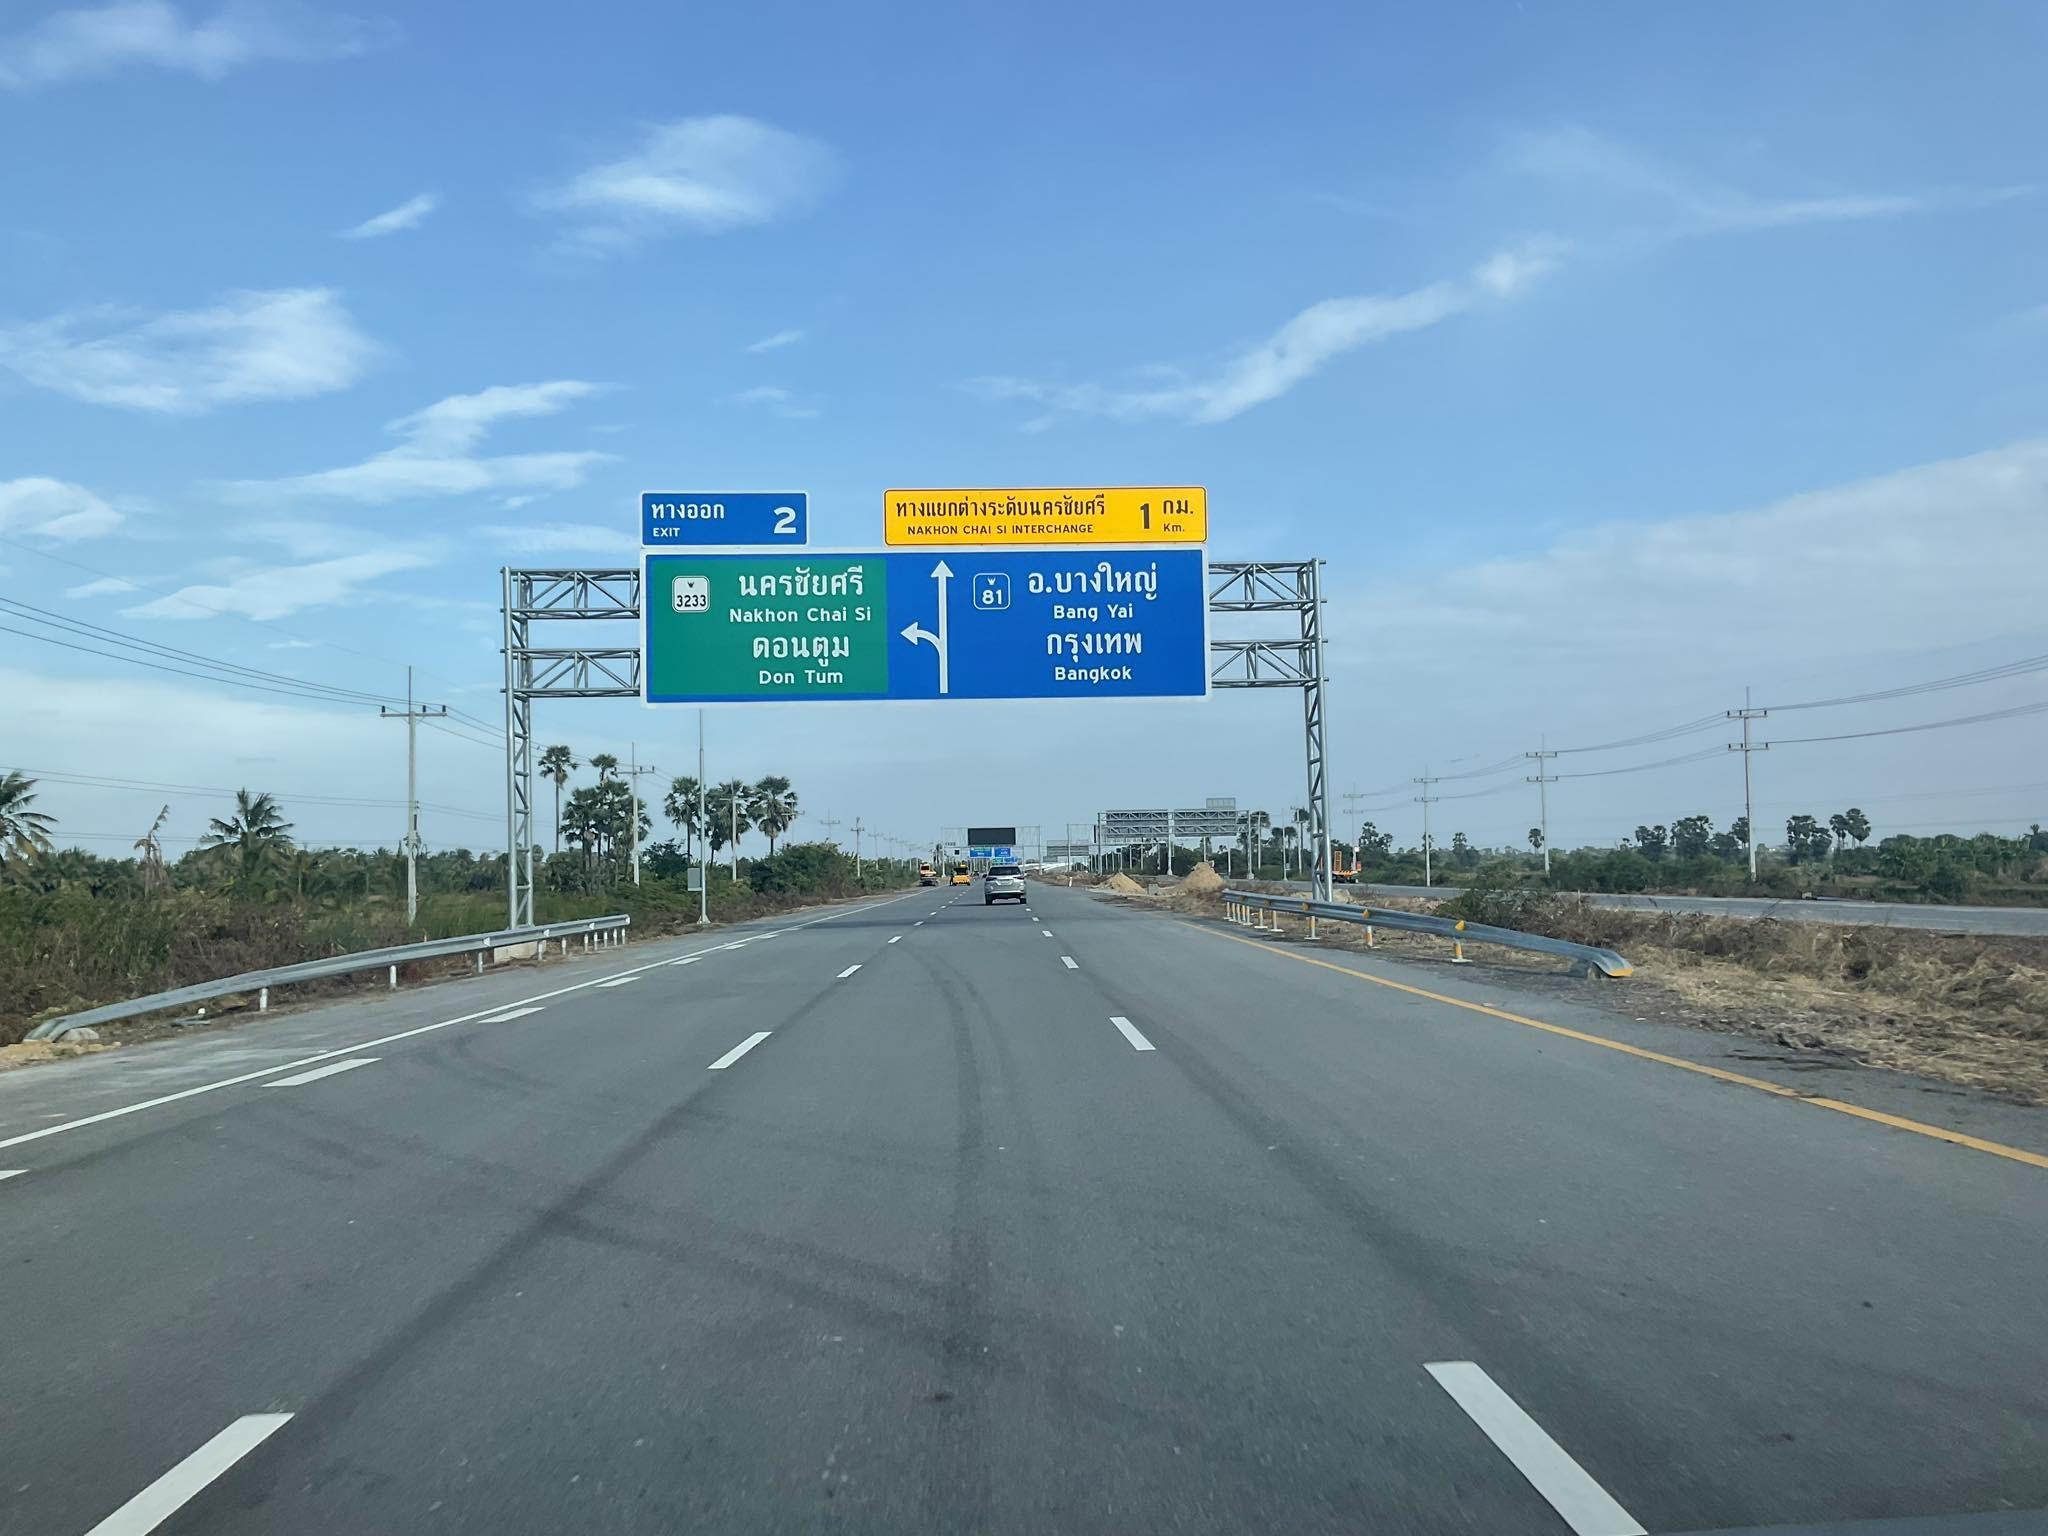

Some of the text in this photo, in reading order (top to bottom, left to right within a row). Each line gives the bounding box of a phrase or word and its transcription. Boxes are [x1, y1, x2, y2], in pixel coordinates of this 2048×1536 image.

[651, 502, 725, 520] ทางออก
[896, 493, 1105, 517] ทางแยกต่างระดับนครชัยศรี
[773, 506, 797, 535] 2
[1140, 499, 1194, 530] 1 กม.
[653, 527, 680, 538] EXIT
[907, 524, 1094, 535] NAKHON CHAI SI INTERCHANGE
[1163, 523, 1185, 533] Km.
[739, 564, 864, 597] นครชัยศรี
[1028, 562, 1158, 600] อ.บางใหญ่
[676, 594, 707, 608] 3233
[981, 589, 1003, 605] 81
[729, 607, 871, 623] Nakhon Chai Si
[1053, 603, 1133, 622] Bang Yai
[753, 635, 849, 667] ดอนตูม
[1047, 632, 1142, 663] กรุงเทพ
[759, 669, 843, 684] Don Tum
[1055, 666, 1132, 684] Bangkok
